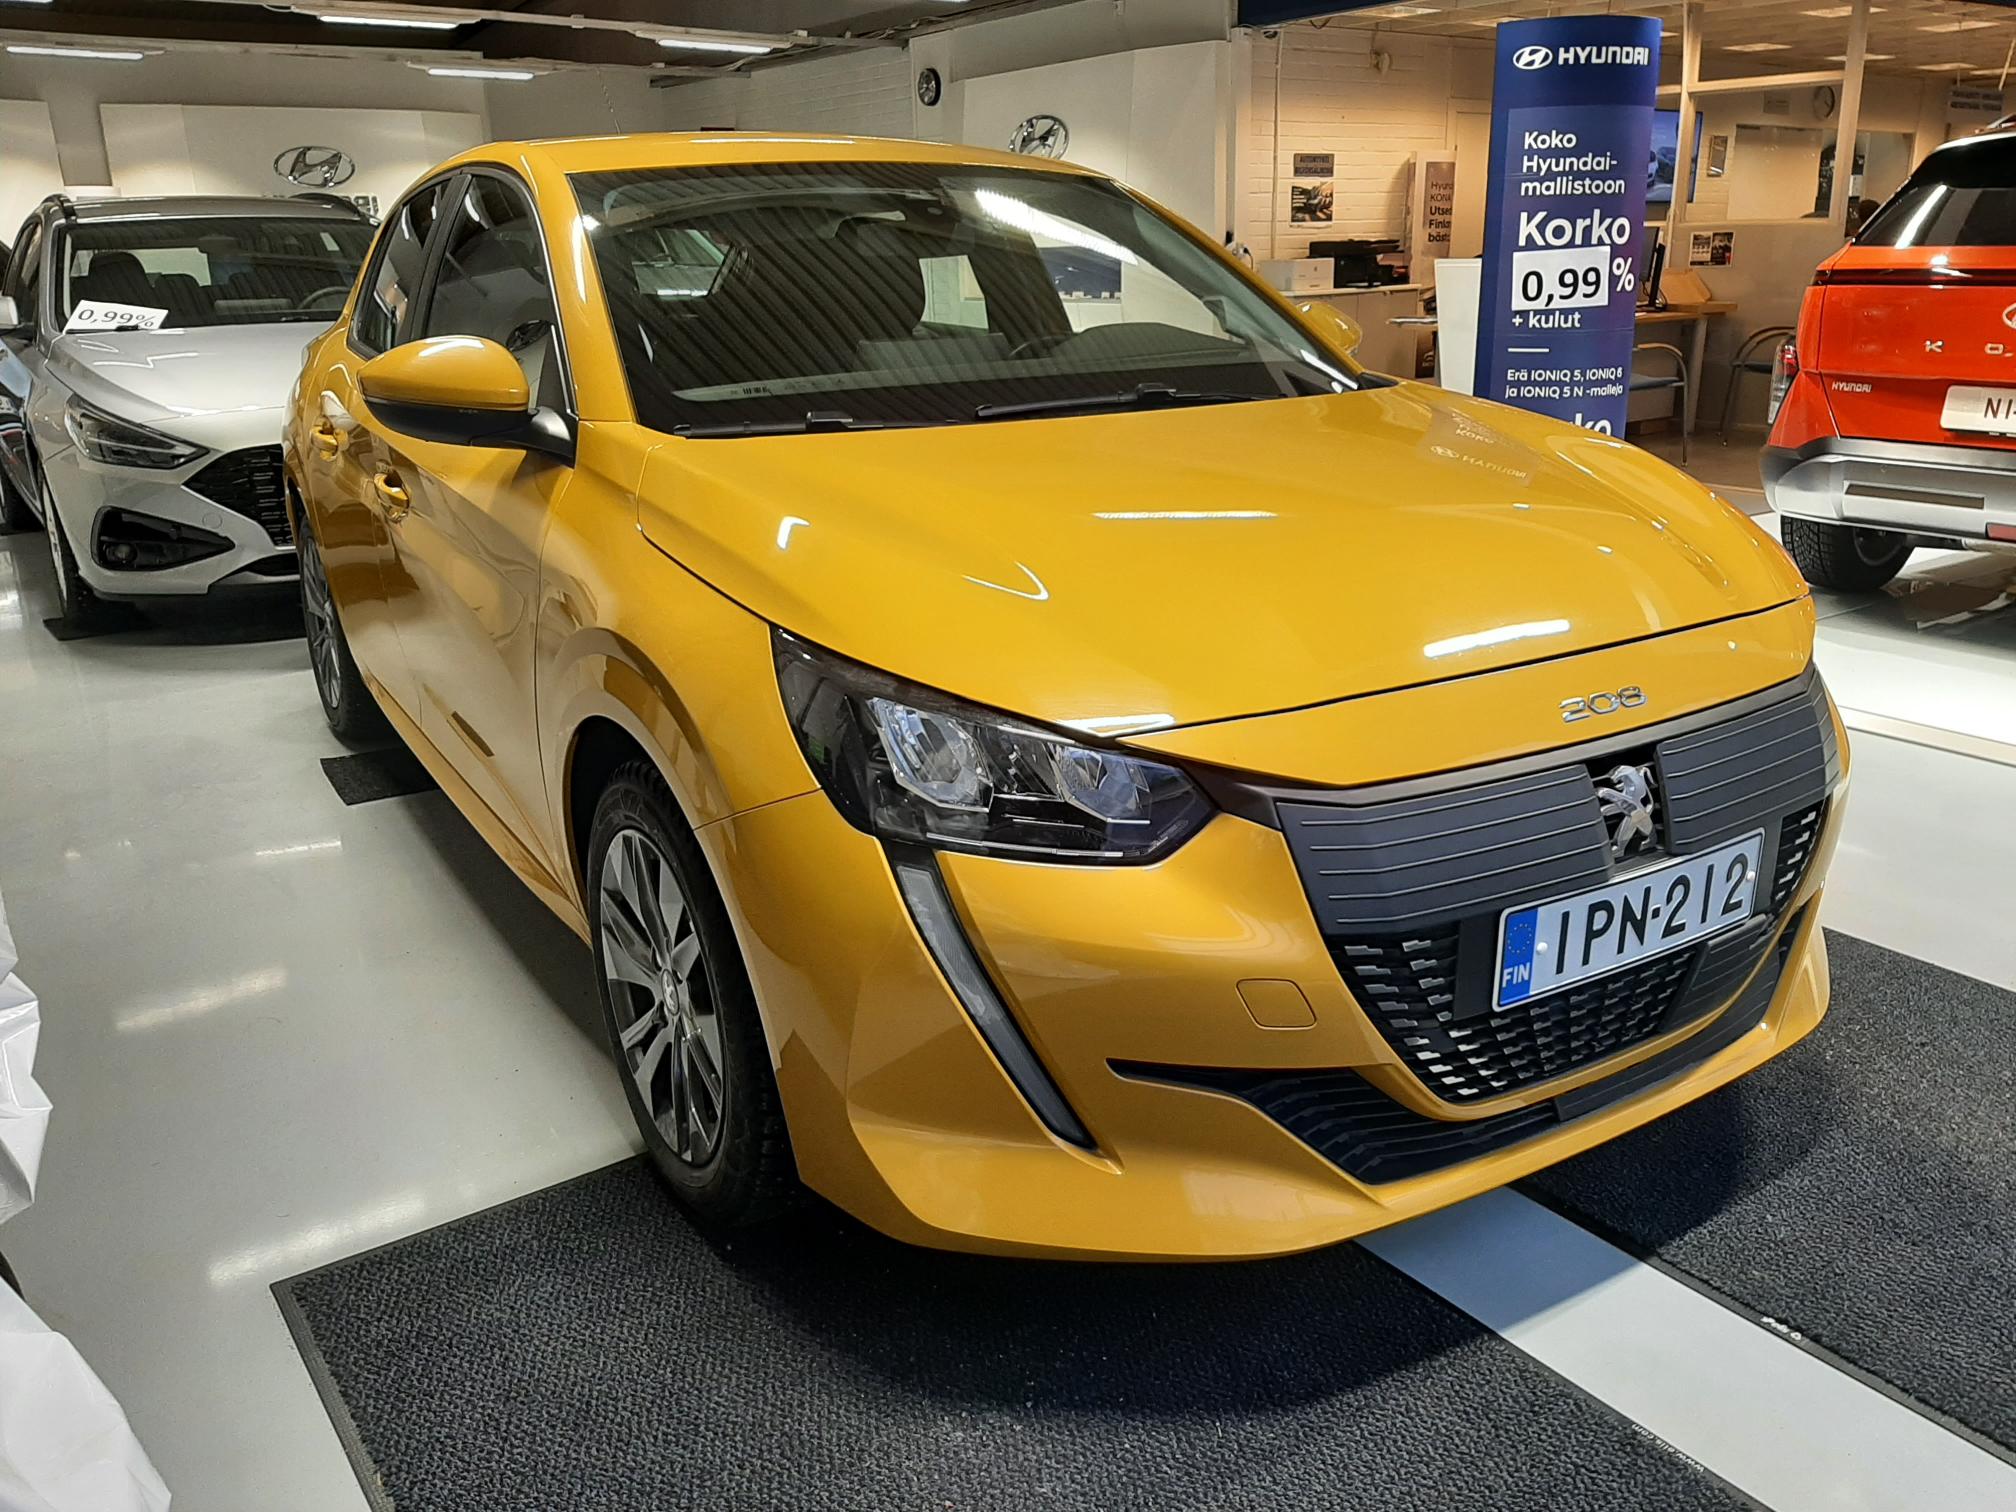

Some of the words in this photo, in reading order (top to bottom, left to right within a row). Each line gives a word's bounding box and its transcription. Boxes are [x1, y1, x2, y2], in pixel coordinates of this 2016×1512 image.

[1558, 46, 1649, 66] HYUNDAI
[1524, 130, 1577, 149] Koko
[1522, 152, 1618, 176] Hyundai-
[1520, 176, 1625, 196] mallistoon
[1518, 208, 1631, 247] Korko
[1521, 266, 1602, 307] 0,99
[1528, 311, 1581, 328] kulut
[1507, 369, 1528, 381] Erä
[1531, 369, 1571, 382] IONIQ
[1573, 369, 1584, 382] 5,
[1586, 368, 1616, 380] IONIQ
[1616, 366, 1623, 378] 6
[1505, 385, 1518, 399] ja
[1520, 386, 1560, 399] IONIQ
[1562, 386, 1571, 397] 5
[1573, 386, 1583, 397] N
[1586, 383, 1623, 397] -malleja
[1832, 381, 1872, 393] HYUNDAI
[1559, 686, 1648, 723] 208
[1555, 852, 1749, 975] IPN-212
[1502, 962, 1530, 988] FIN
